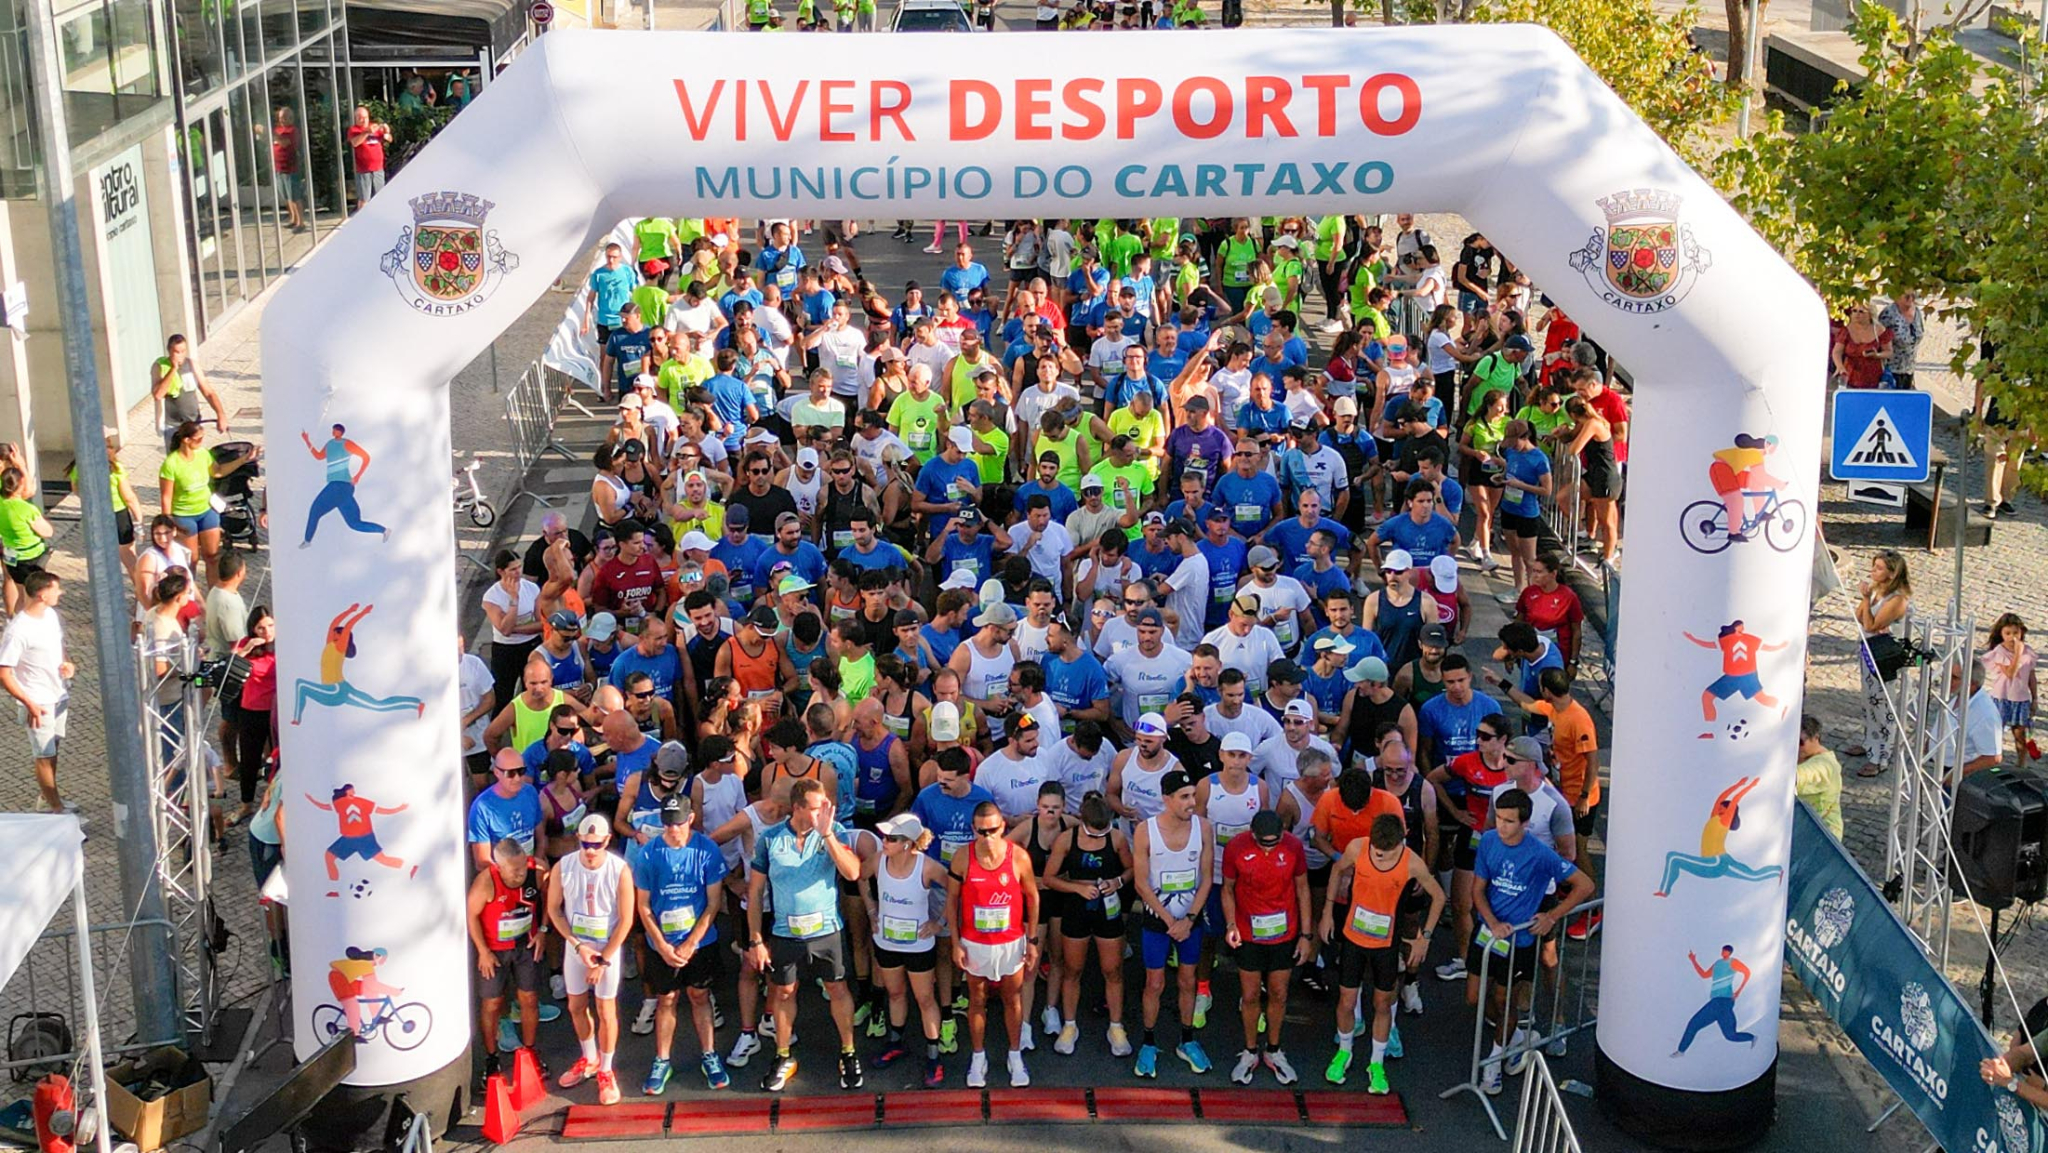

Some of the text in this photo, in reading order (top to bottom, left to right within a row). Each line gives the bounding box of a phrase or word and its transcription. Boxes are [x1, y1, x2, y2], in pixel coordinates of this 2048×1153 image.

[673, 73, 1422, 141] VIVER DESPORTO
[696, 155, 1394, 199] MUNICÍPIO DO CARTAXO
[414, 294, 484, 315] CARTAXO
[1603, 292, 1676, 313] CARTAXO
[1786, 918, 1846, 992] CARTAXO
[1871, 1015, 1948, 1100] CARTAXO
